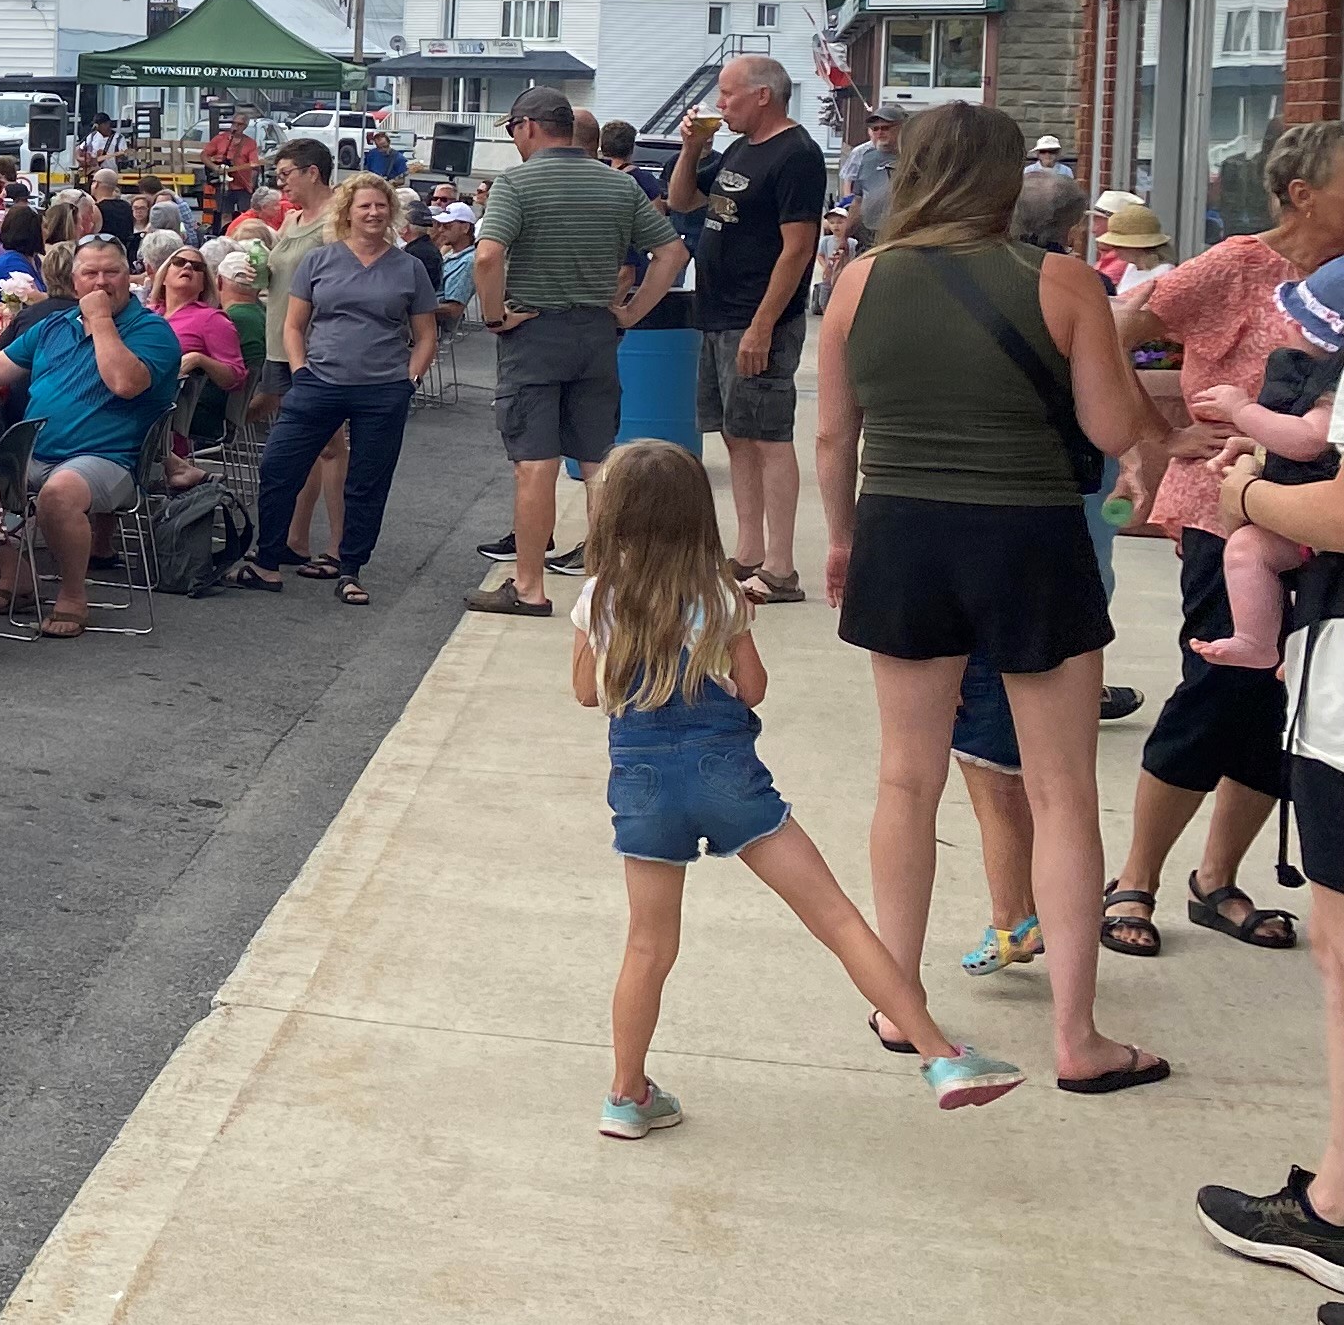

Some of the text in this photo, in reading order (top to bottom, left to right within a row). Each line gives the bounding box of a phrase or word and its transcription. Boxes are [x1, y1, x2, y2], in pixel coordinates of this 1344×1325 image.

[142, 65, 307, 79] TOWNSHIP OF NORTH DUNDAS
